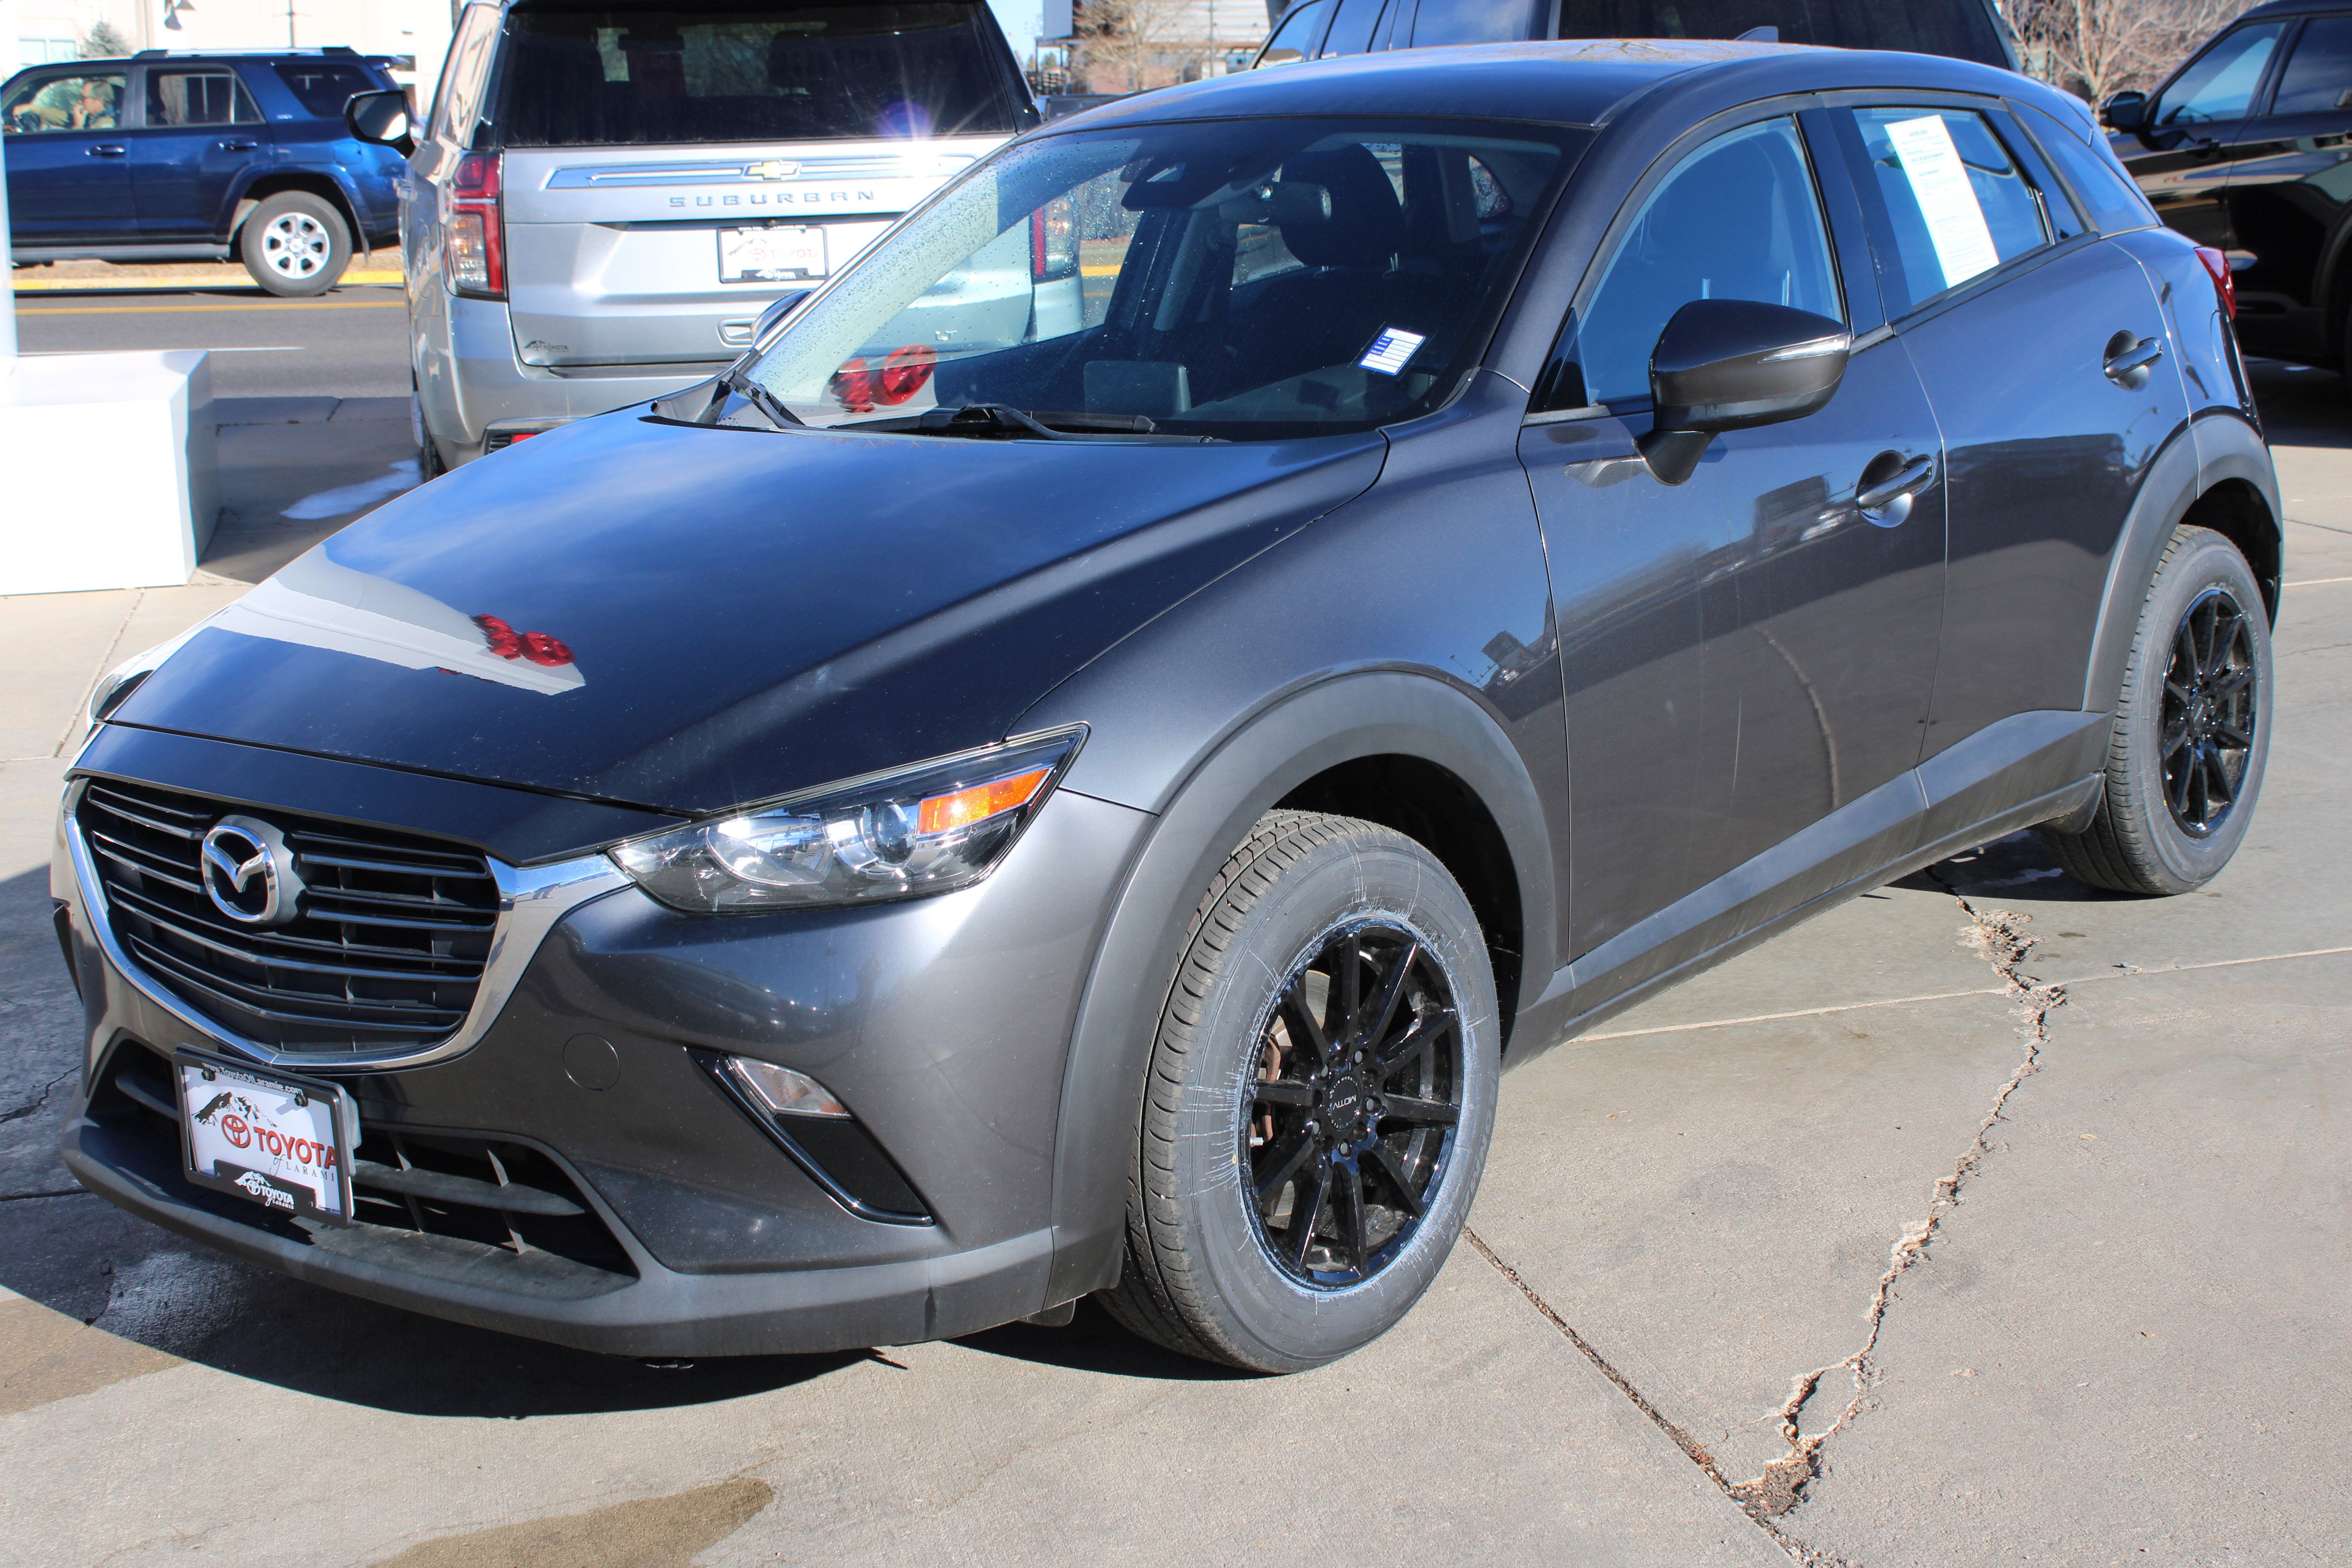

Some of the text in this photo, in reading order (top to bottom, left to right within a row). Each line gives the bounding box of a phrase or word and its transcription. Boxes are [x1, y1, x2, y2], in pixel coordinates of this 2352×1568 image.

[669, 191, 875, 207] SUBURBAN
[1332, 1095, 1356, 1110] MOTIV
[253, 1126, 337, 1169] TOYOTA
[270, 1154, 335, 1181] of LARAMI
[1448, 1070, 1497, 1246] IRONMAN
[261, 1185, 295, 1205] TOYOTA
[272, 1199, 295, 1210] LARAMIE
